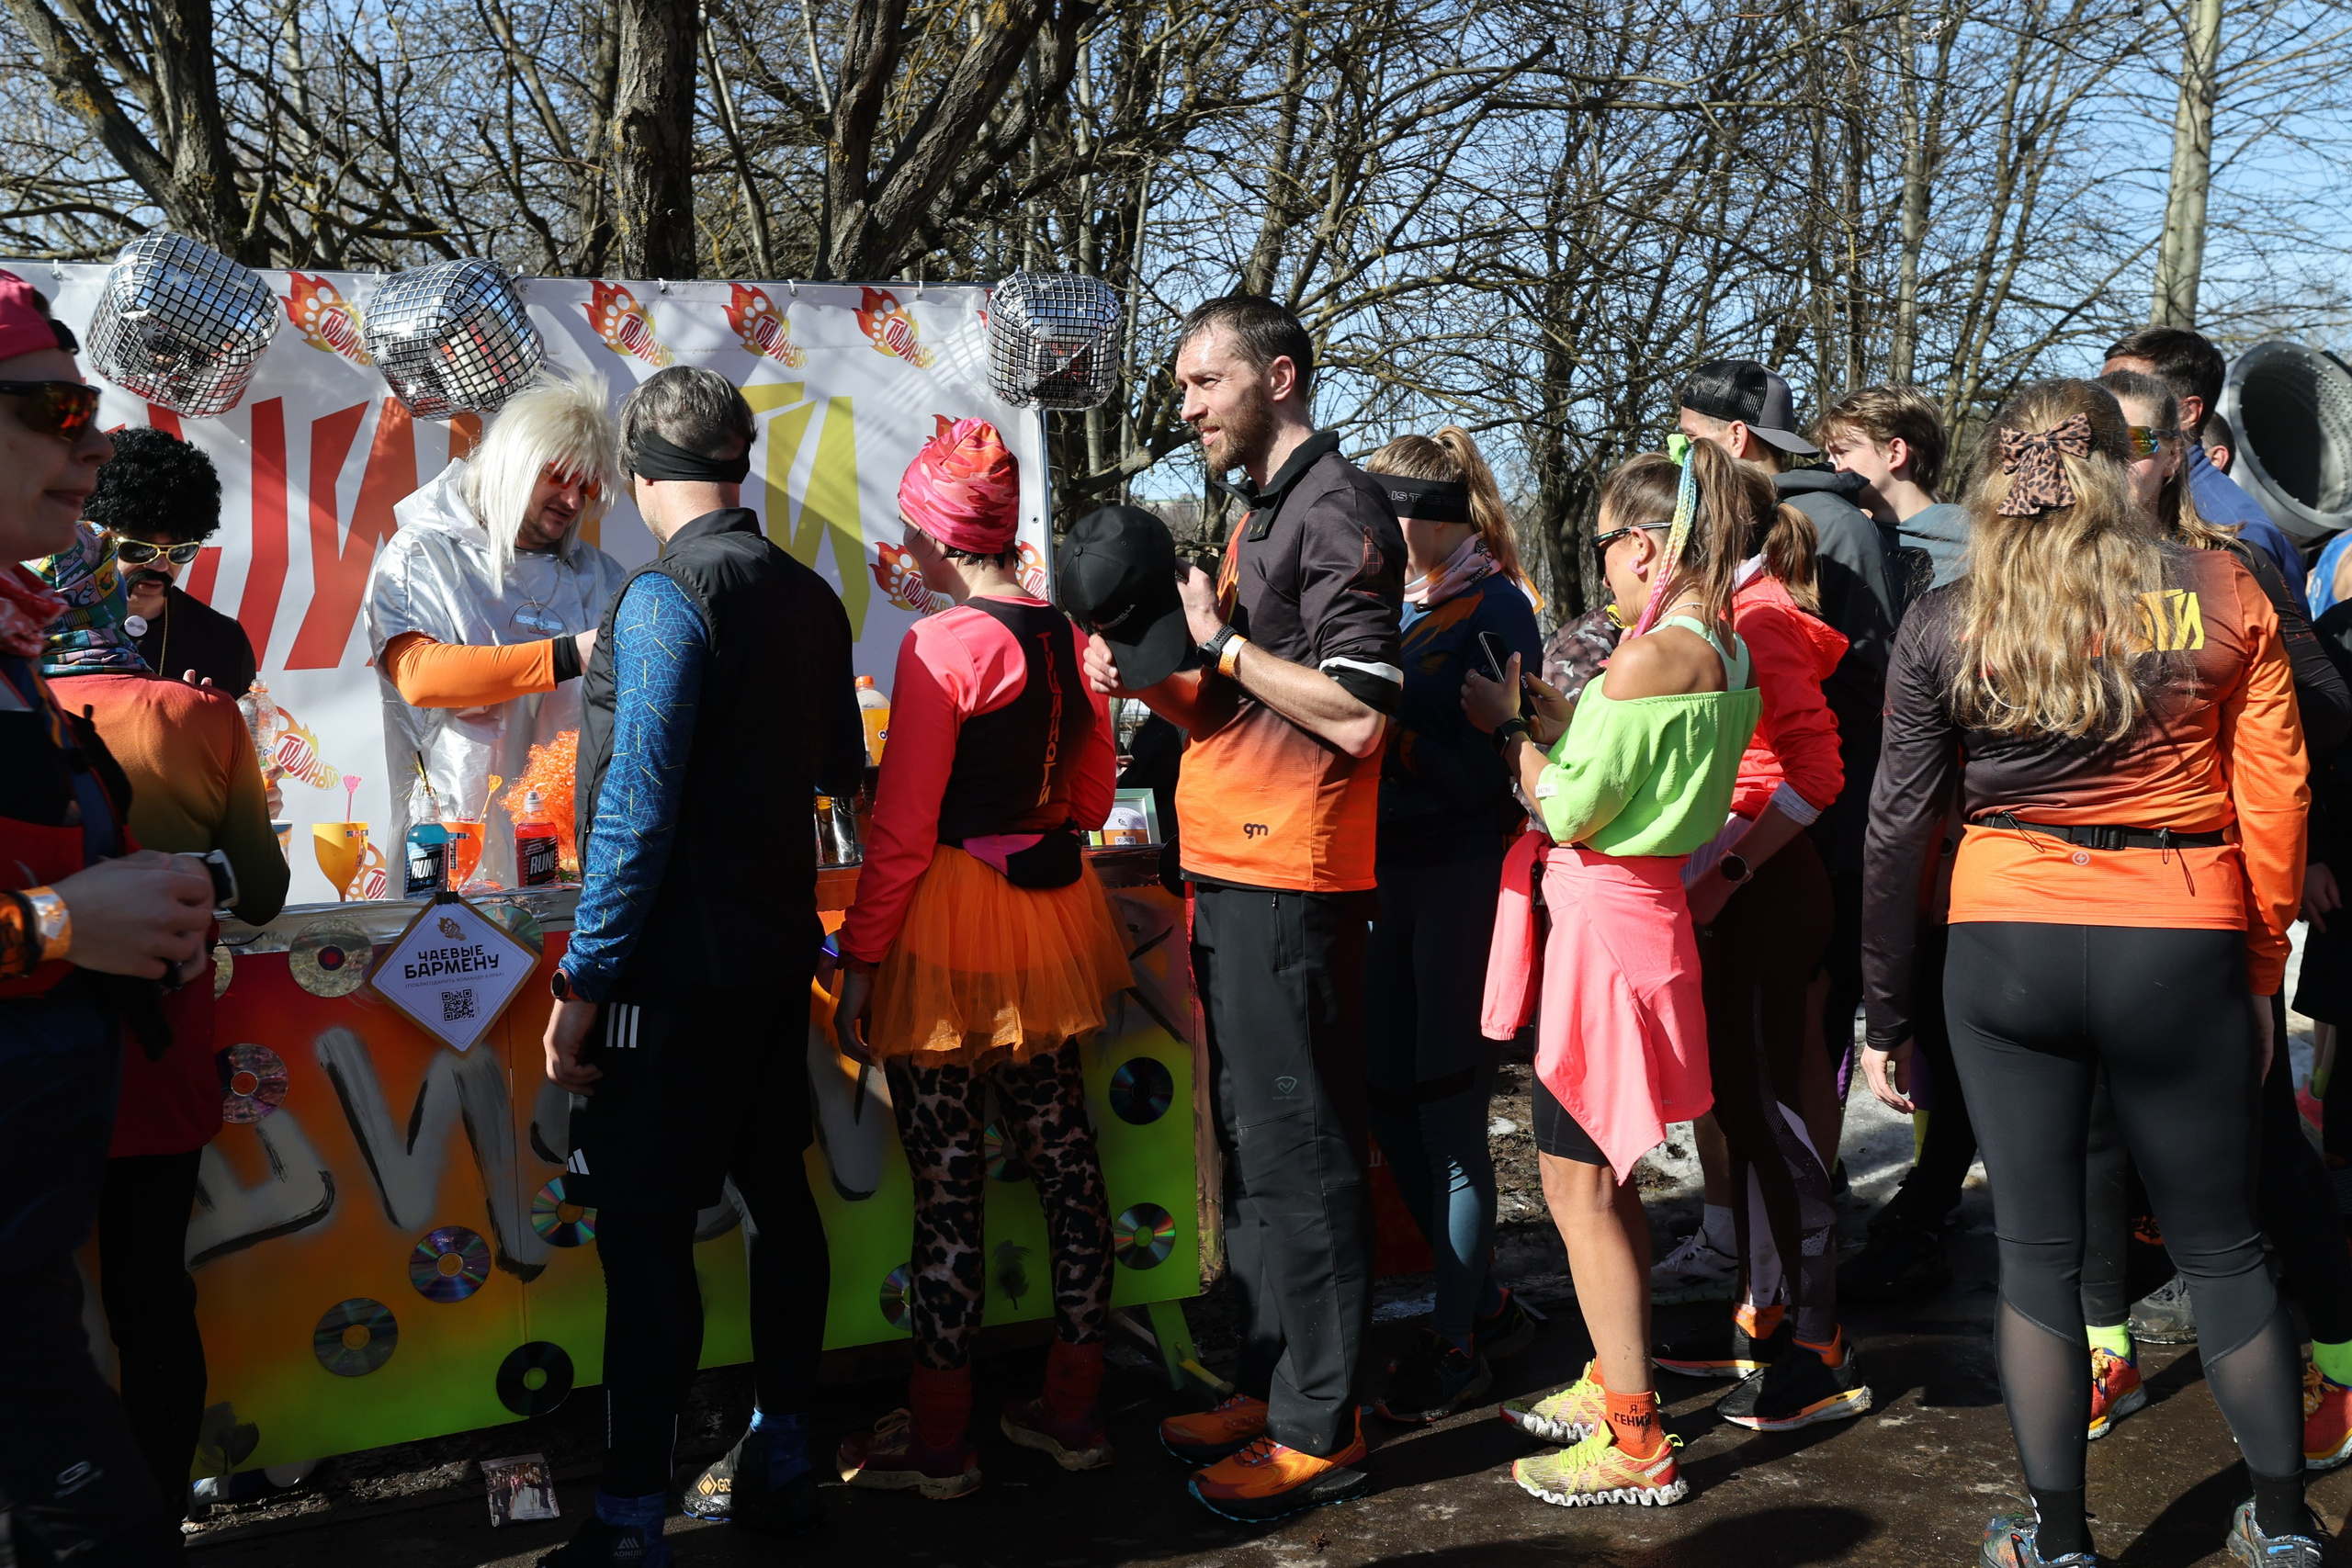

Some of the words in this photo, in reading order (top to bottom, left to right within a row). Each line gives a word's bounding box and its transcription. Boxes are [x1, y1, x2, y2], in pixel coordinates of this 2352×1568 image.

[1391, 491, 1408, 502] IS
[1244, 823, 1269, 840] gm
[411, 857, 439, 879] RUN!
[530, 851, 555, 874] RUN!
[418, 944, 484, 962] ЧАЕВЫЕ
[404, 953, 499, 979] БАРМЕНУ
[405, 978, 456, 989] (ПОБЛАГОДАРИТЬ
[457, 975, 484, 983] КОМАНДУ
[485, 971, 504, 980] КЛУБА)
[1630, 1404, 1637, 1415] Я
[1614, 1412, 1652, 1427] ГЕНИЙ
[1644, 1456, 1674, 1478] Reebok
